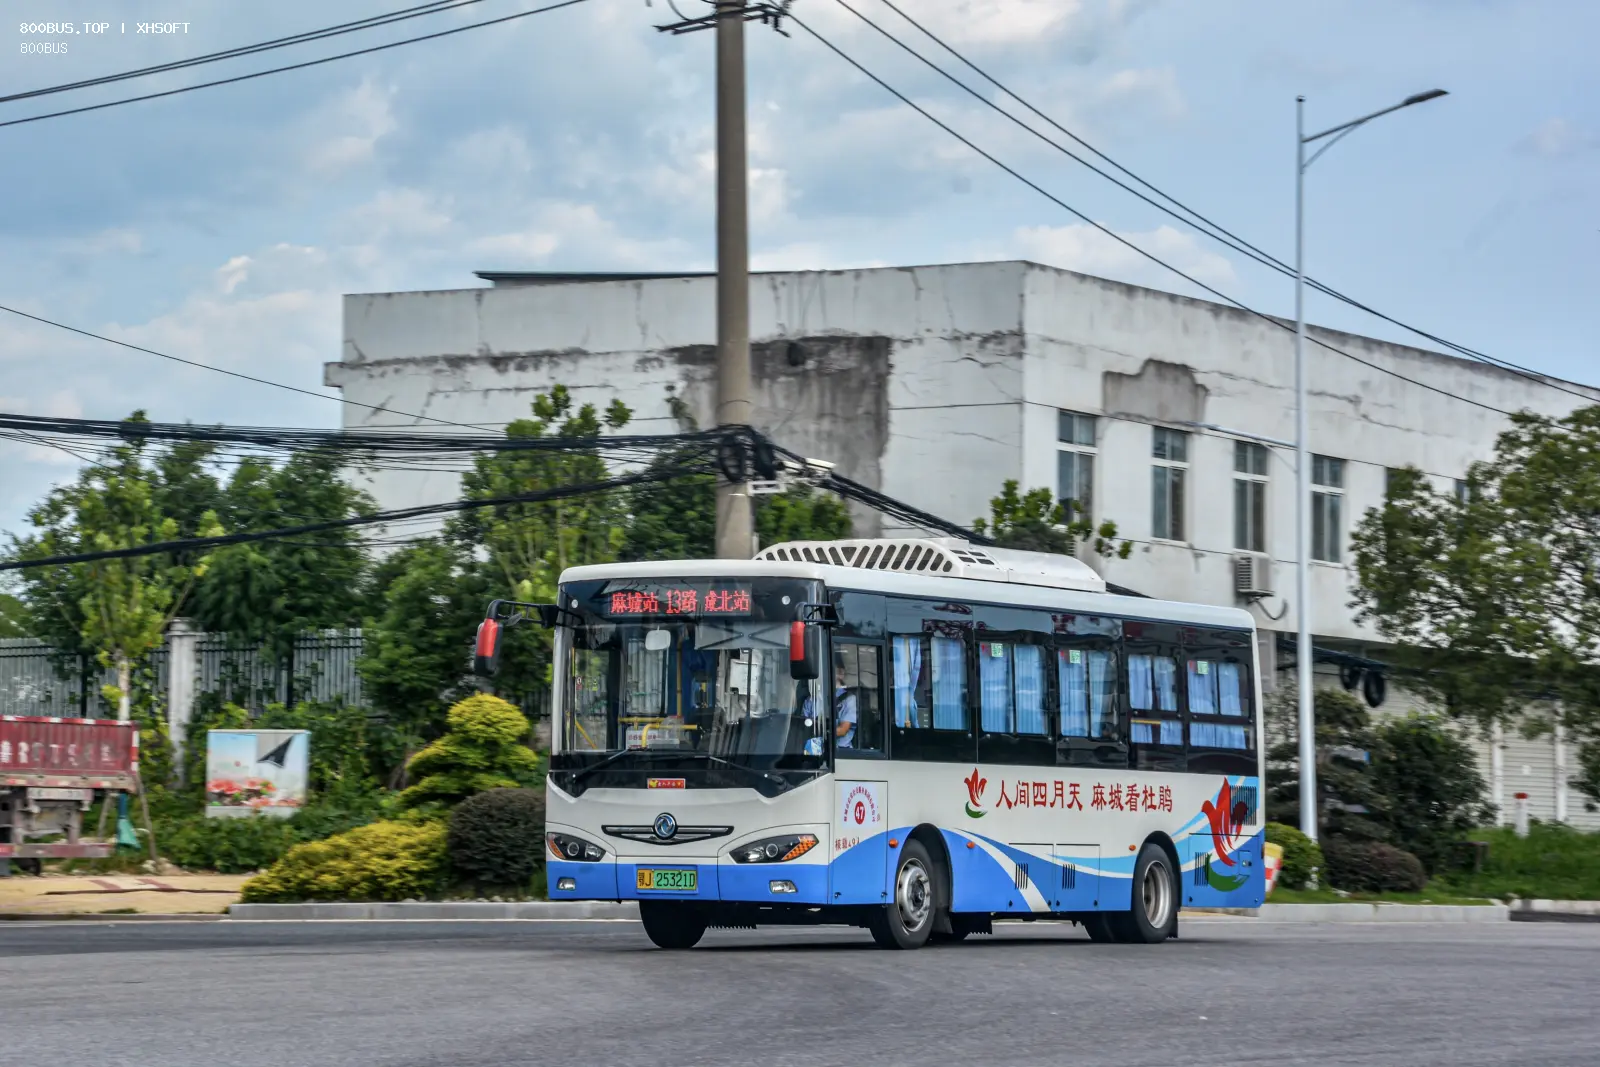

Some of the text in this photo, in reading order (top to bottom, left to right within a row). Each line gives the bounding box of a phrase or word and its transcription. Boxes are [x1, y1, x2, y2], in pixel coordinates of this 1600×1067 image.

[665, 589, 698, 614] 13路
[995, 779, 1174, 813] 人间四月天 麻城看杜鹃
